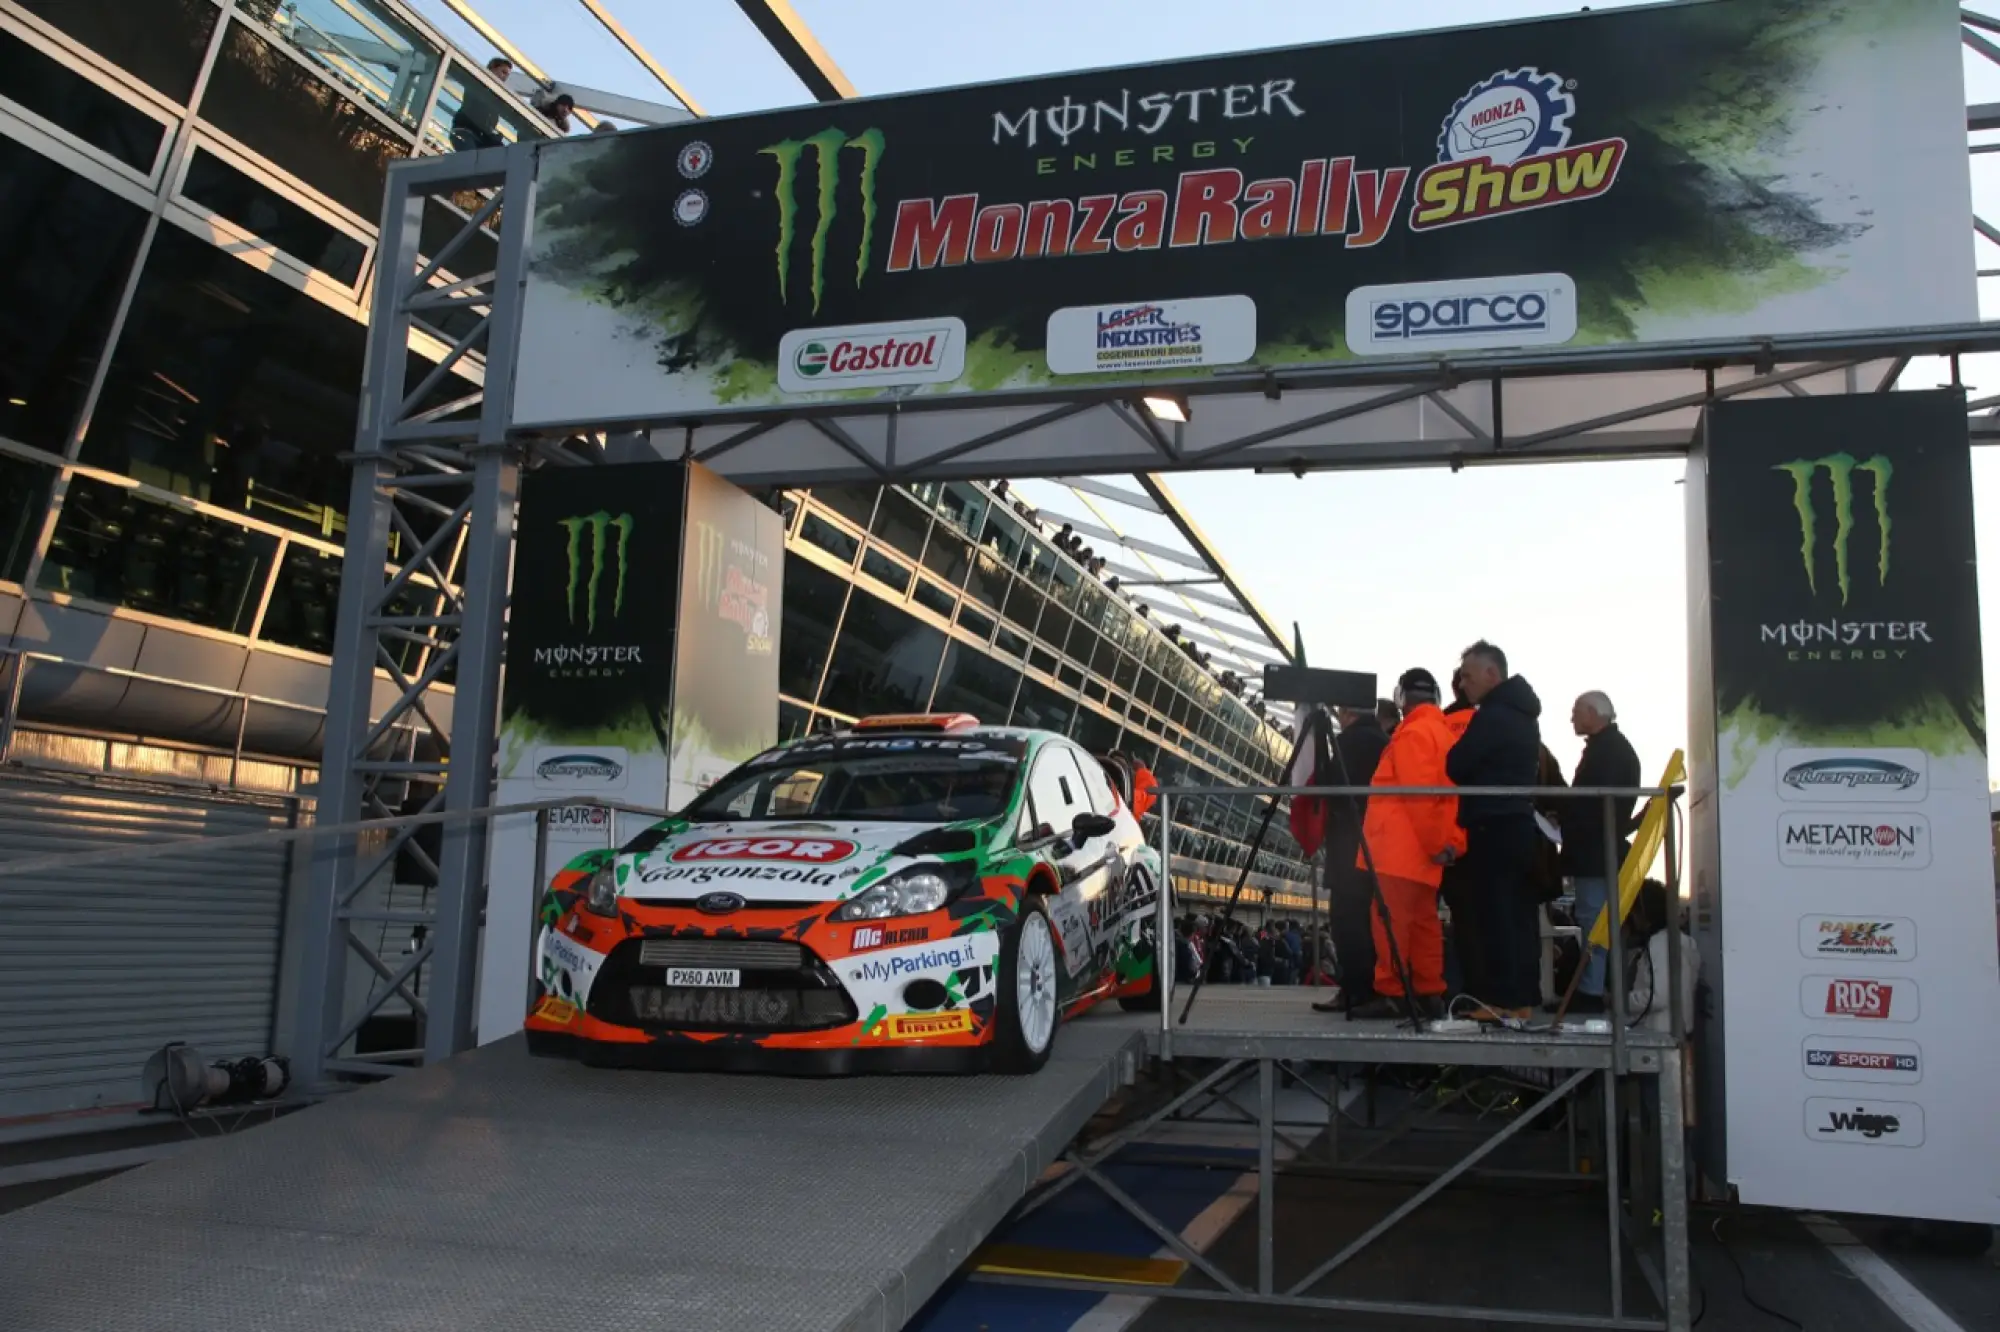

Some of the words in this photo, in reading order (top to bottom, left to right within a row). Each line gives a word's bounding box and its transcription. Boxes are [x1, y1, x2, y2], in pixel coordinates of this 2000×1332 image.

[992, 78, 1305, 148] MONSTER
[1471, 97, 1526, 127] MONZA
[1037, 137, 1254, 174] ENERGY
[1418, 146, 1616, 224] Show
[1374, 294, 1546, 339] sparco
[829, 334, 937, 373] Castrol
[1760, 617, 1934, 647] MONSTER
[534, 643, 642, 668] MONSTER
[1788, 650, 1907, 661] ENERGY
[549, 668, 625, 678] ENERGY
[1786, 824, 1915, 846] METATRON
[685, 840, 835, 859] IGOR
[641, 866, 836, 887] Gorgonzola
[863, 944, 975, 982] MyParking.it
[672, 970, 702, 985] PX60
[706, 972, 734, 985] AVM
[1834, 983, 1880, 1010] RDS
[896, 1015, 963, 1034] PIRELLI
[1809, 1049, 1832, 1066] sky
[1838, 1054, 1890, 1067] SPORT
[1896, 1059, 1914, 1068] HD
